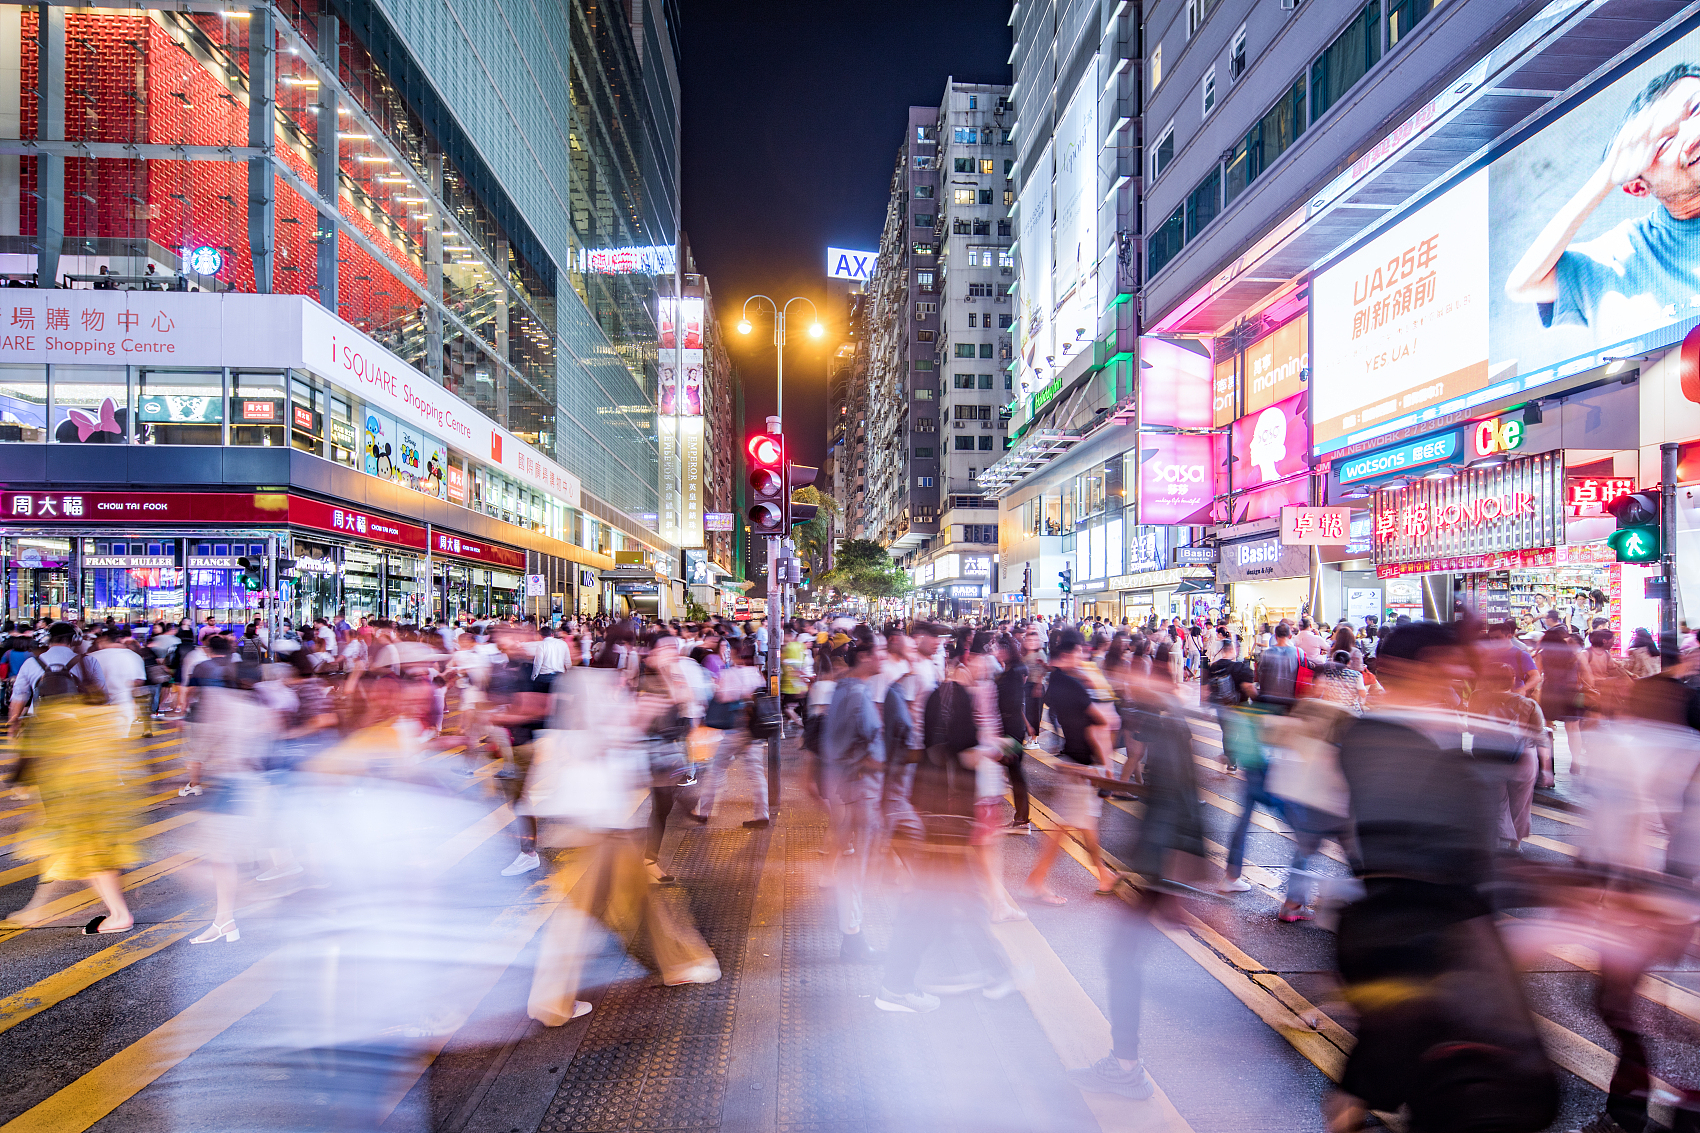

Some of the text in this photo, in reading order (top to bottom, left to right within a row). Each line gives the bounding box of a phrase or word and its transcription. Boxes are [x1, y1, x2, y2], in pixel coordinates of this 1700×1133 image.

[1353, 233, 1439, 306] UA25年
[1352, 270, 1437, 341] 創新領前
[0, 307, 175, 333] 場購物中心
[0, 335, 175, 356] ARE Shopping Centre
[1365, 351, 1387, 374] YES
[332, 336, 472, 440] i SQUARE Shopping Centre
[1331, 449, 1345, 460] JM
[1347, 432, 1400, 454] NETWORK
[1404, 408, 1472, 437] 27230020
[690, 436, 698, 481] EMPEROR
[1346, 439, 1446, 478] watsons 屈臣氏
[12, 495, 168, 516] 周大福 CHOW TAI FOOK
[1435, 491, 1535, 528] BONJOUR
[333, 509, 367, 534] 周大福
[439, 535, 461, 553] 周大福
[85, 557, 172, 566] FRANCK MULLER
[190, 558, 231, 567] FRANCK
[1246, 568, 1261, 576] design
[1265, 566, 1274, 575] life
[1381, 566, 1399, 578] SALE
[1493, 554, 1517, 569] SALE
[952, 586, 978, 597] RADO
